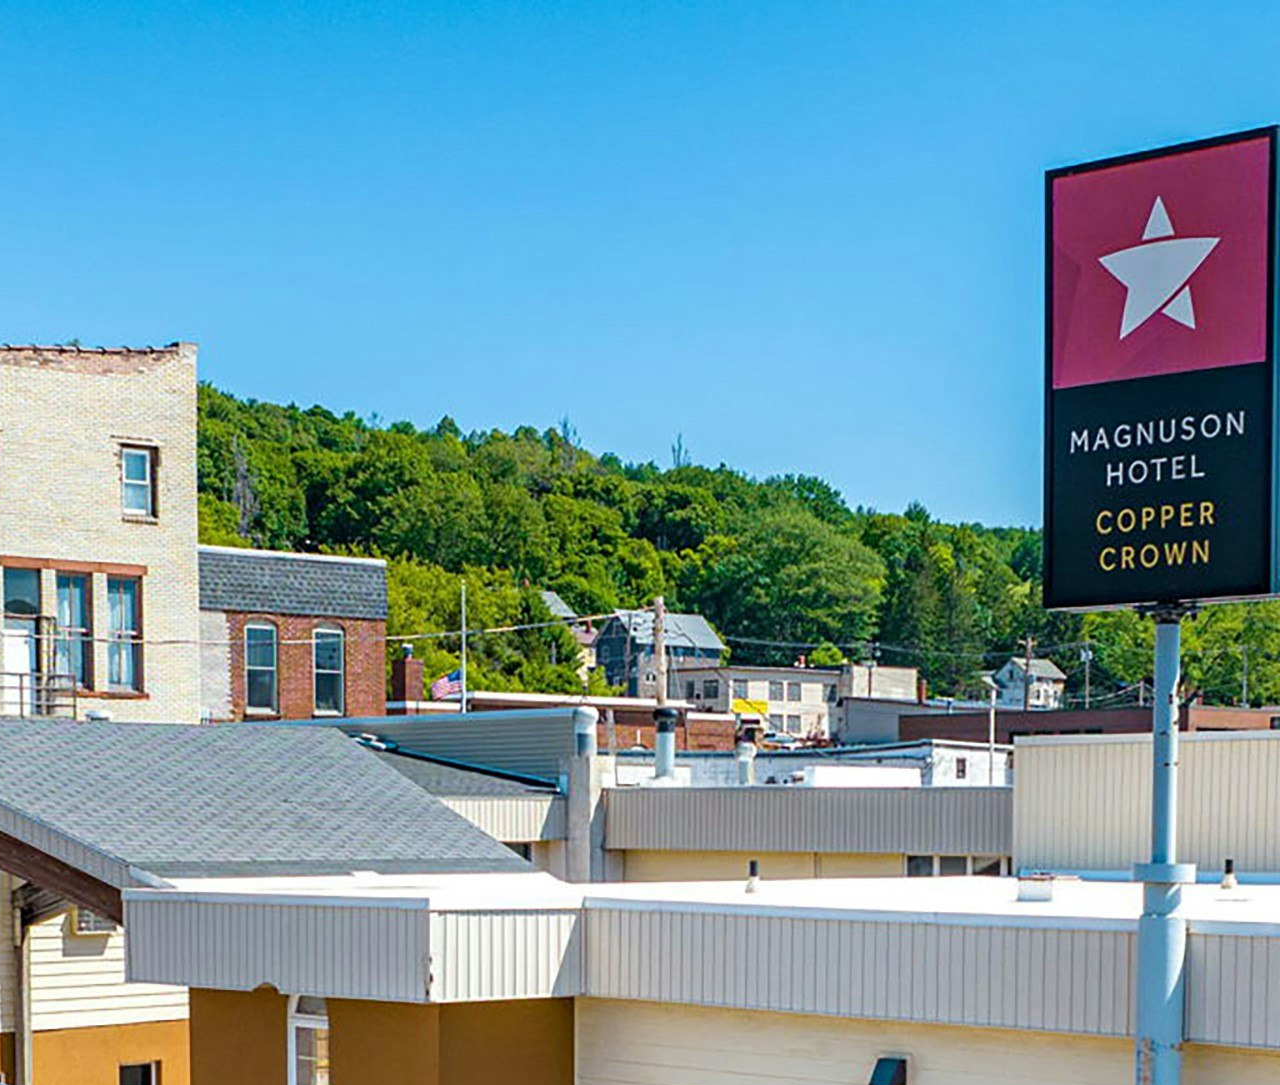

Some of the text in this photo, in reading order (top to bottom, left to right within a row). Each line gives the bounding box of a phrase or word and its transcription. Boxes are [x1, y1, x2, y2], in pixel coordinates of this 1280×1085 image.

[1070, 411, 1245, 453] MAGNUSON
[1106, 455, 1205, 486] HOTEL
[1096, 502, 1215, 534] COPPER
[1099, 540, 1210, 571] CROWN
